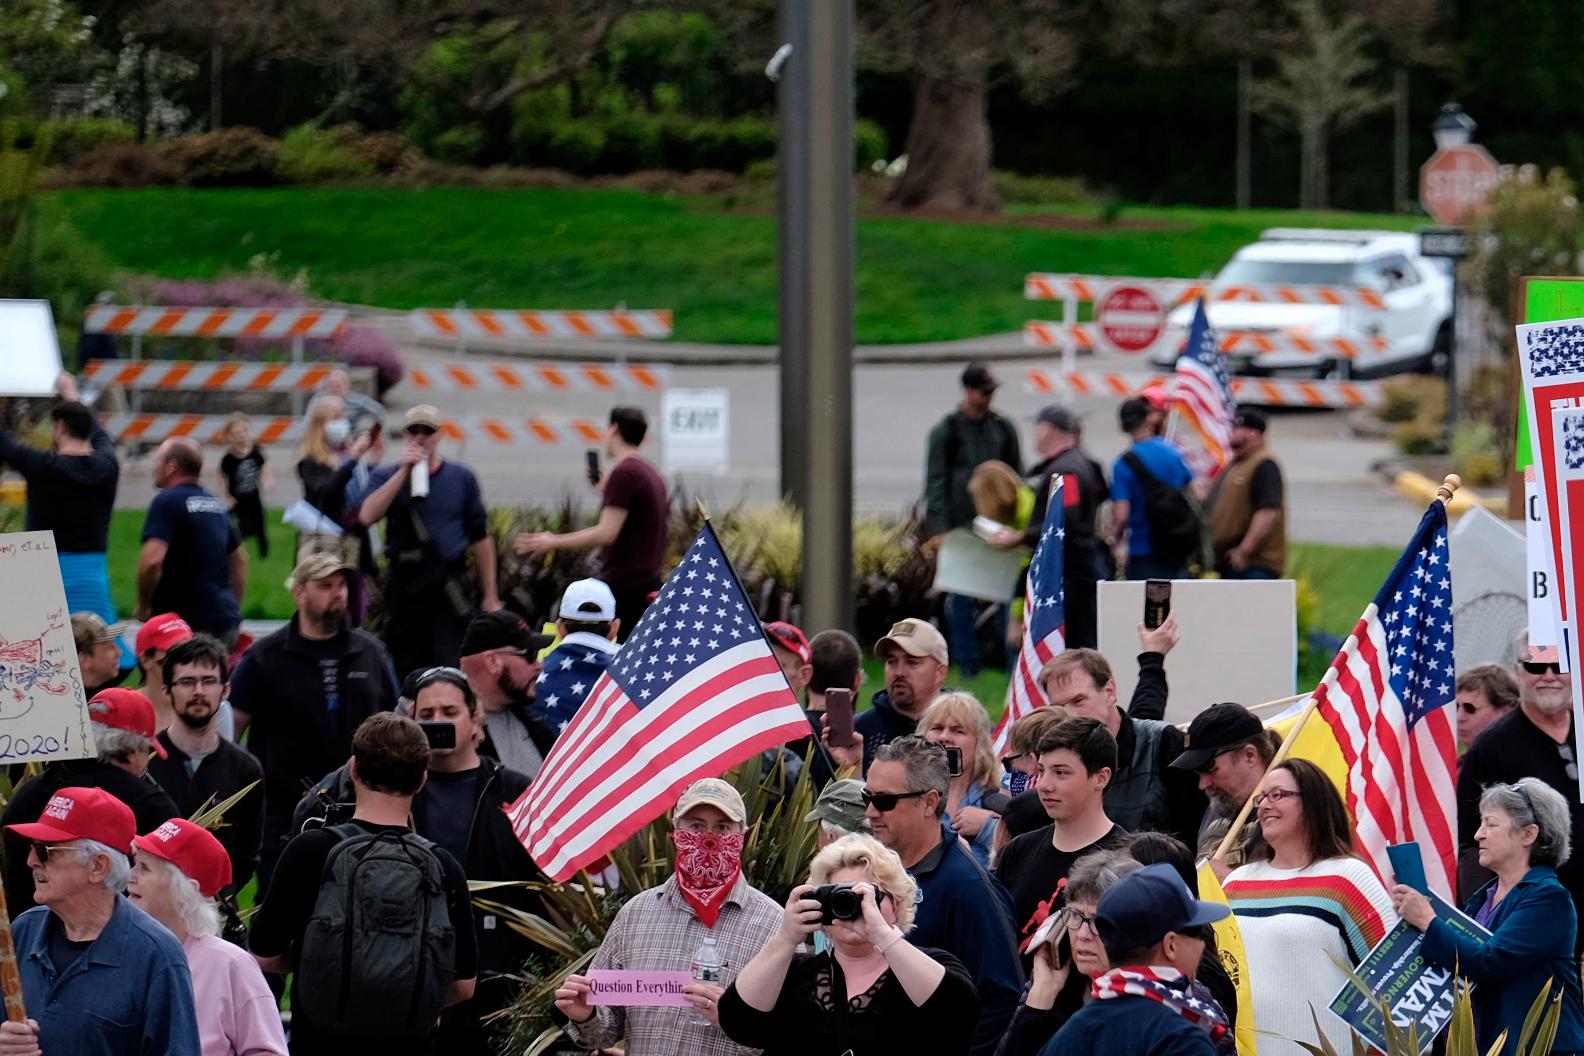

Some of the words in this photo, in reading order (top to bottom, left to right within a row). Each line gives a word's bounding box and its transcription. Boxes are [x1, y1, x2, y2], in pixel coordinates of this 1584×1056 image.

[589, 978, 633, 996] Question
[636, 980, 685, 997] Everythin
[1383, 955, 1425, 1003] GOVERNO
